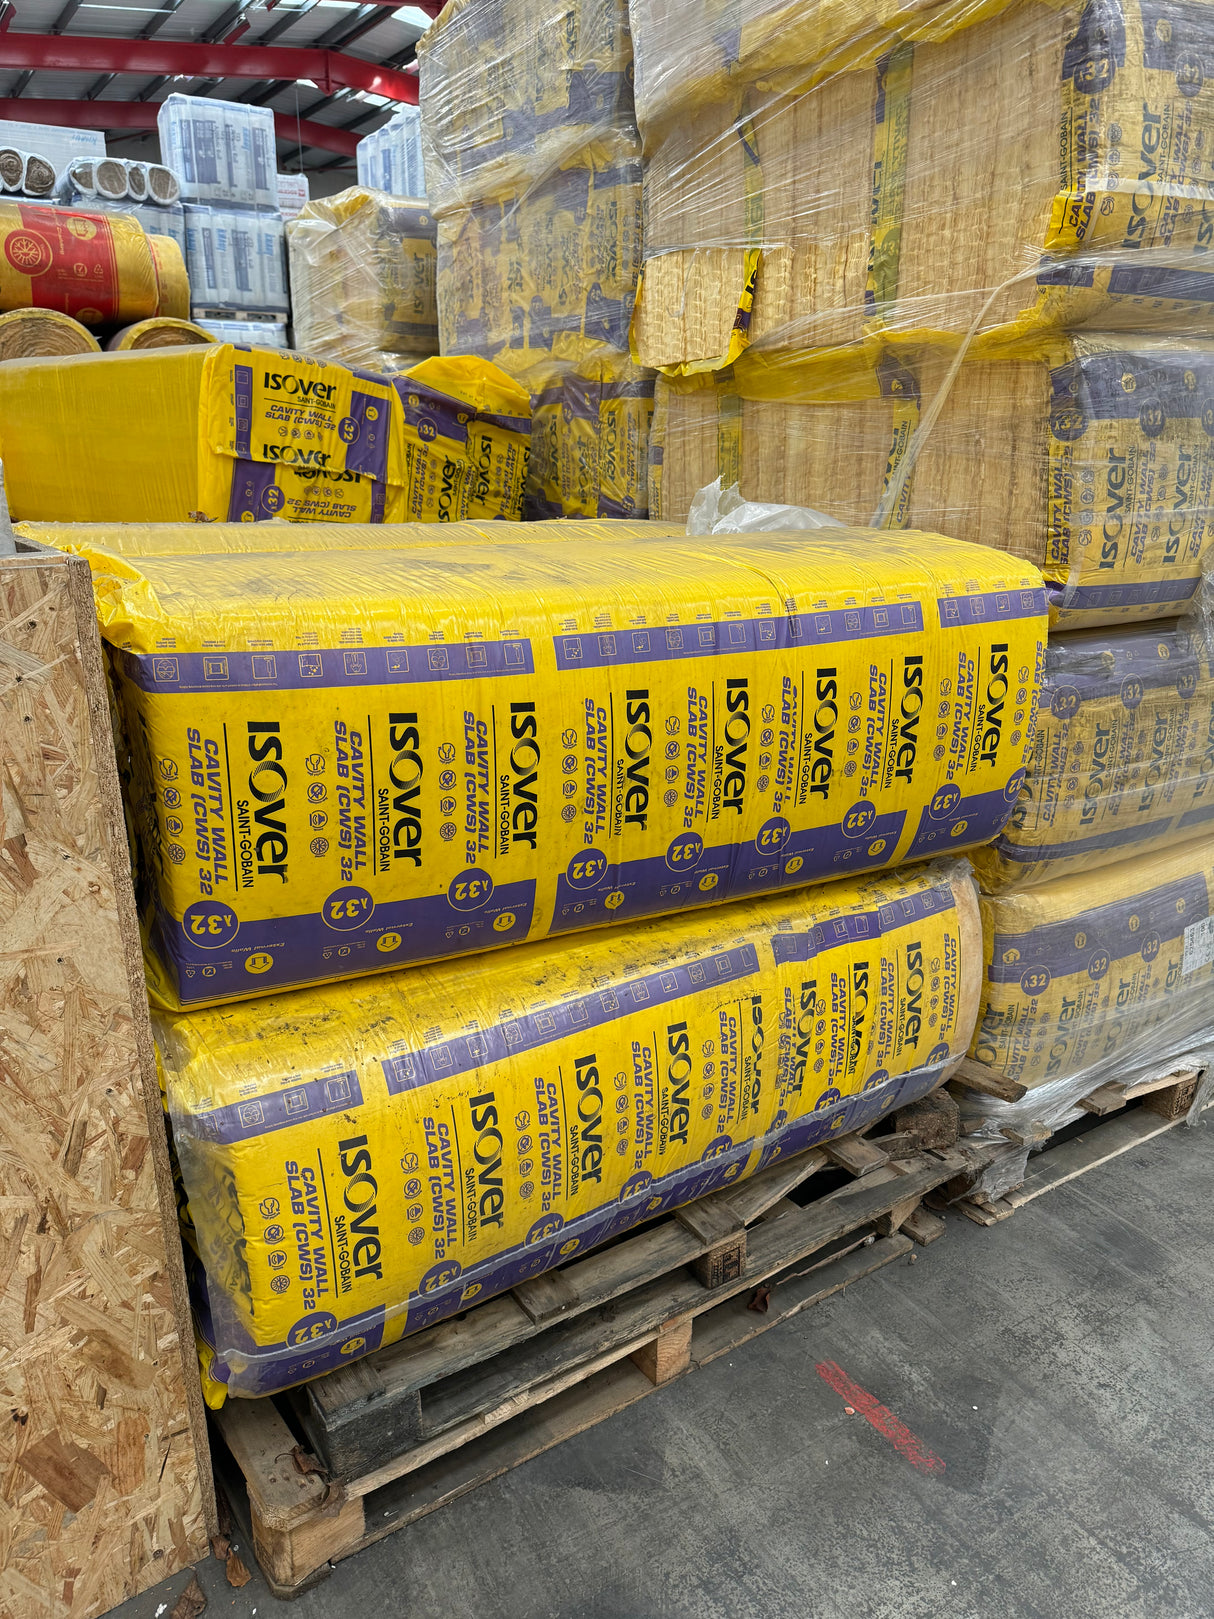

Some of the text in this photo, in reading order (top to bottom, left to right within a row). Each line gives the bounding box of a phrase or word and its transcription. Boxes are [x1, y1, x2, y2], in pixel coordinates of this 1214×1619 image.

[1060, 111, 1069, 191] SAINT-GOBAIN
[1076, 98, 1099, 240] SLAB 32
[1077, 111, 1088, 165] WALL
[265, 412, 336, 431] SLAB (CWS) 32
[271, 405, 332, 422] CAVITY WALL
[298, 396, 336, 408] SAINT-GOBAIN
[293, 506, 351, 518] CAVITY WALL
[332, 504, 357, 512] SLAB
[1051, 454, 1063, 560] CAVITY WALL
[1125, 446, 1136, 515] SAINT-GOBAIN
[1060, 526, 1071, 564] SLAB
[684, 687, 697, 828] SLAB (CWS) 32
[695, 696, 707, 818] CAVITY WALL
[773, 676, 791, 813] SLAB (CWS) 32
[859, 664, 877, 797] SLAB (CWS) 32
[870, 673, 886, 788] CAVITY WALL
[884, 719, 899, 788] SAINT-GOBAIN
[946, 652, 966, 780] SLAB (CWS) 32
[956, 660, 974, 771] CAVITY WALL
[970, 704, 985, 772] SAINT-GOBAIN
[204, 739, 228, 884] CAVITY WALL
[335, 720, 352, 881] SLAB (CWS) 32
[350, 731, 366, 870] CAVITY WALL
[464, 711, 476, 864] SLAB (CWS) 32
[476, 720, 489, 853] CAVITY WALL
[584, 698, 595, 844] SLAB (CWS) 32
[595, 708, 607, 834] CAVITY WALL
[614, 759, 624, 836] SAINT-GOBAIN
[712, 746, 723, 819] SAINT-GOBAIN
[799, 733, 812, 804] SAINT-GOBAIN
[1043, 773, 1055, 821] CAVITY
[1051, 732, 1061, 770] WALL
[187, 728, 213, 896] SLAB (CWS) 32
[237, 800, 254, 888] SAINT-GOBAIN
[378, 788, 390, 872] SAINT-GOBAIN
[500, 775, 510, 855] SAINT-GOBAIN
[719, 1011, 728, 1054] SLAB
[784, 987, 792, 1029] SLAB
[835, 978, 846, 1076] CAVITY WALL
[878, 1002, 887, 1045] (CWS)
[884, 1020, 893, 1058] WALL
[896, 998, 906, 1056] SAINT-GOBAIN
[938, 977, 950, 1040] (CWS) 32
[946, 995, 955, 1032] WALL
[1007, 1038, 1020, 1076] CAVITY
[1016, 1006, 1030, 1035] WALL
[726, 1017, 737, 1120] CAVITY WALL
[876, 1051, 882, 1067] 32
[534, 1078, 551, 1212] SLAB (CWS) 32
[548, 1083, 561, 1200] CAVITY WALL
[632, 1042, 643, 1170] SLAB 32
[642, 1047, 654, 1158] CAVITY WALL
[660, 1087, 669, 1155] SAINT-GOBAIN
[423, 1118, 446, 1260] SLAB (CWS) 32
[438, 1124, 457, 1247] CAVITY WALL
[570, 1125, 579, 1196] SAINT-GOBAIN
[286, 1161, 316, 1310] SLAB (CWS) 32
[302, 1168, 328, 1298] CAVITY WALL
[465, 1168, 477, 1242] SAINT-GOBAIN
[335, 1216, 352, 1293] SAINT-GOBAIN
